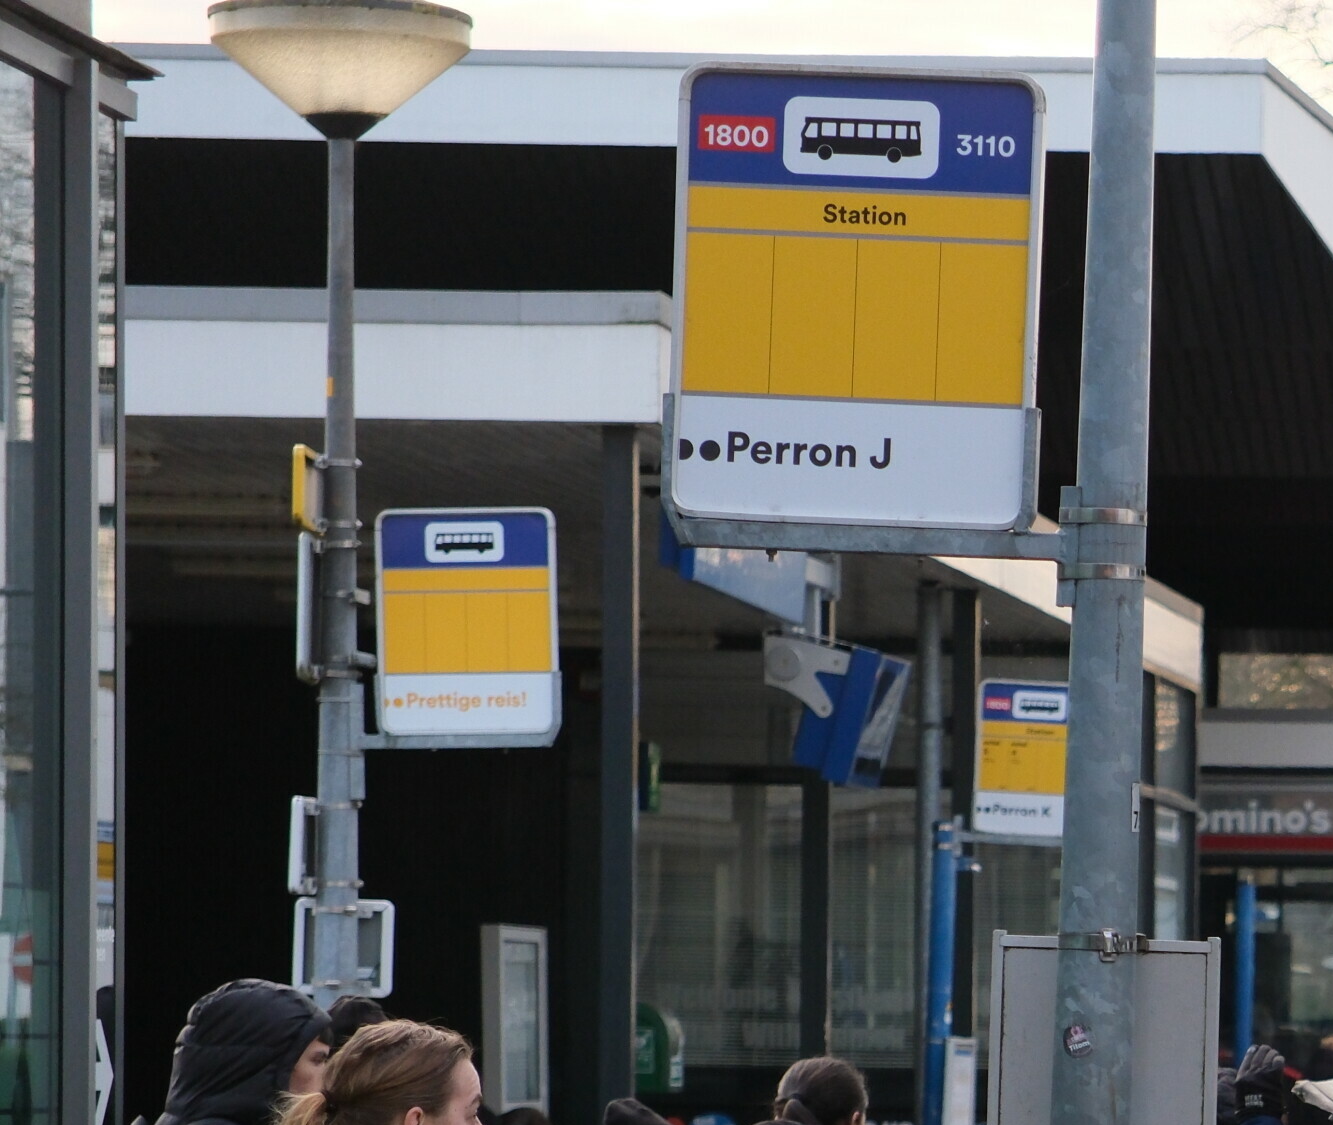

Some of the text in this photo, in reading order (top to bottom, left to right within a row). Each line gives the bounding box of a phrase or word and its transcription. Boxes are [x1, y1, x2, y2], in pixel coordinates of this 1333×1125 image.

[703, 123, 769, 148] 1800
[956, 134, 1015, 158] 3110
[823, 203, 907, 227] Station
[727, 431, 892, 469] Perron J
[406, 691, 528, 712] Prettige reis!
[992, 804, 1051, 817] Perron K
[1197, 800, 1332, 834] omino's
